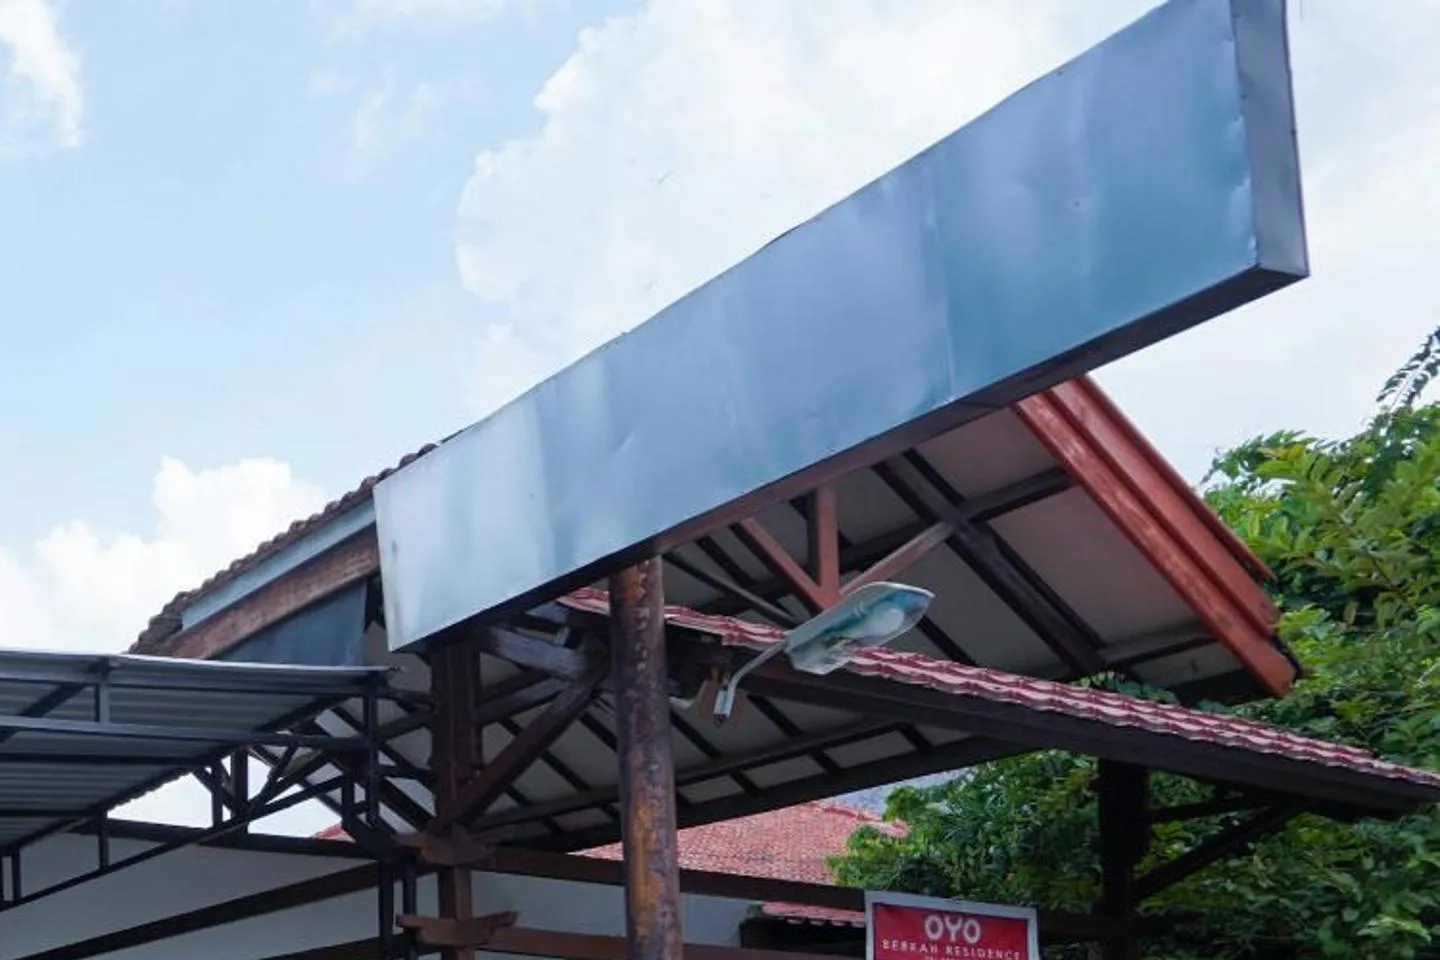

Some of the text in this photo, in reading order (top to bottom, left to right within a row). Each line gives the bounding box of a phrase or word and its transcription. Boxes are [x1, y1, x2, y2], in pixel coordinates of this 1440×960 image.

[924, 914, 981, 945] OYO
[881, 939, 1021, 960] BERKAH RESIDENCE
